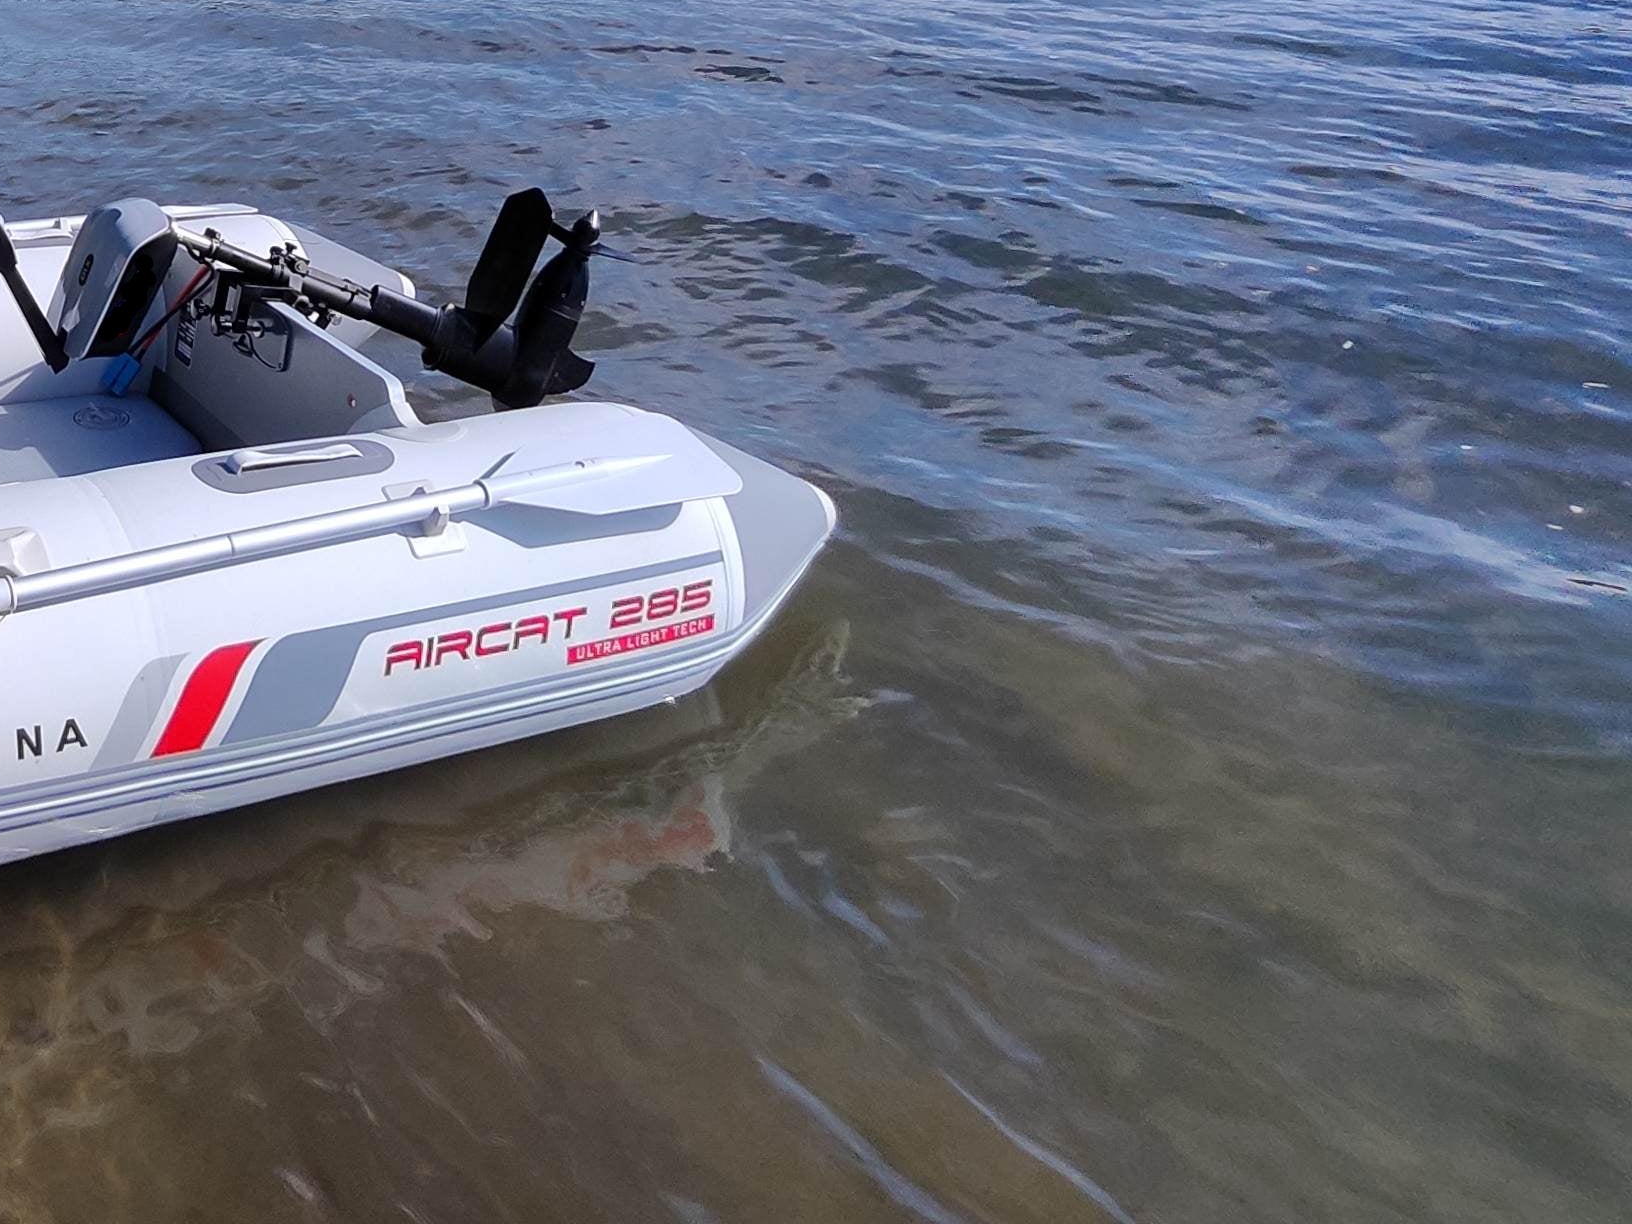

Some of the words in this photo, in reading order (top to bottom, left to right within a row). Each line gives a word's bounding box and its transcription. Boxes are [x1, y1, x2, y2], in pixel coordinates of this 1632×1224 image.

[384, 607, 587, 677] AIRCAT
[609, 579, 713, 630] 285
[575, 640, 622, 660] ULTRA
[626, 628, 669, 649] LIGHT
[672, 618, 707, 637] TECH
